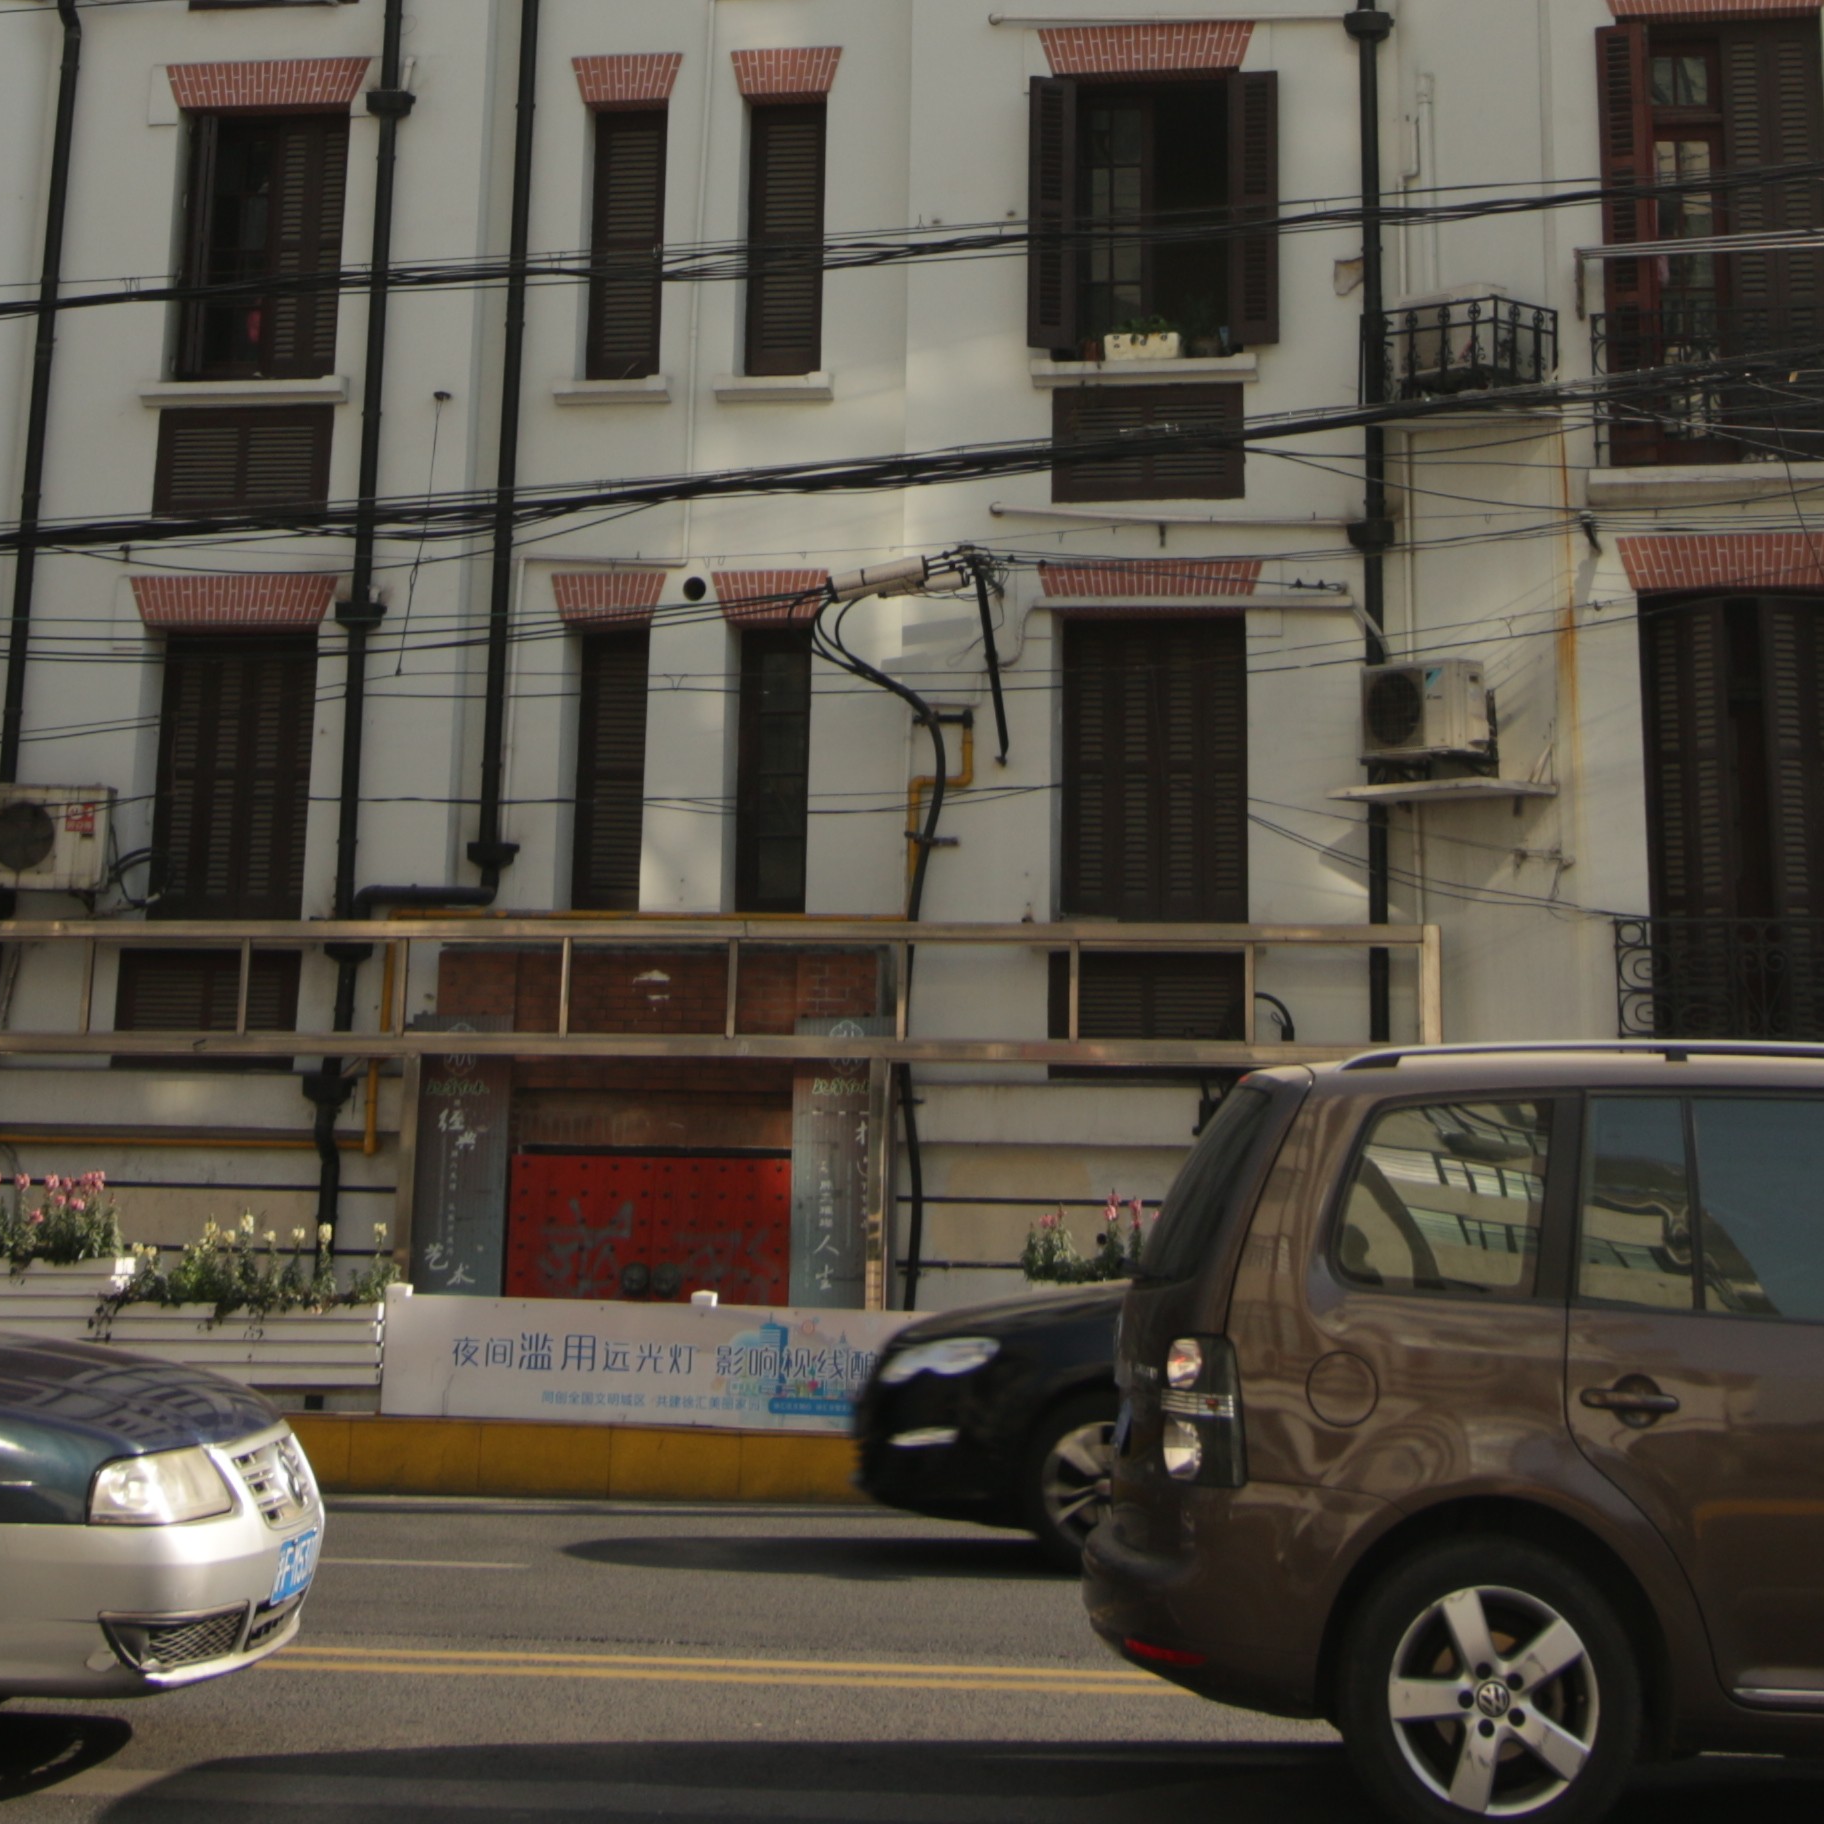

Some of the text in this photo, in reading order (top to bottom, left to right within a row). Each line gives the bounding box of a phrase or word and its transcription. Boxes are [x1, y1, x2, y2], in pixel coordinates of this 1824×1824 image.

[425, 1242, 476, 1286] 艺术
[451, 1331, 699, 1375] 夜间滥用远光灯
[541, 1390, 646, 1408] 同创全国文明城区
